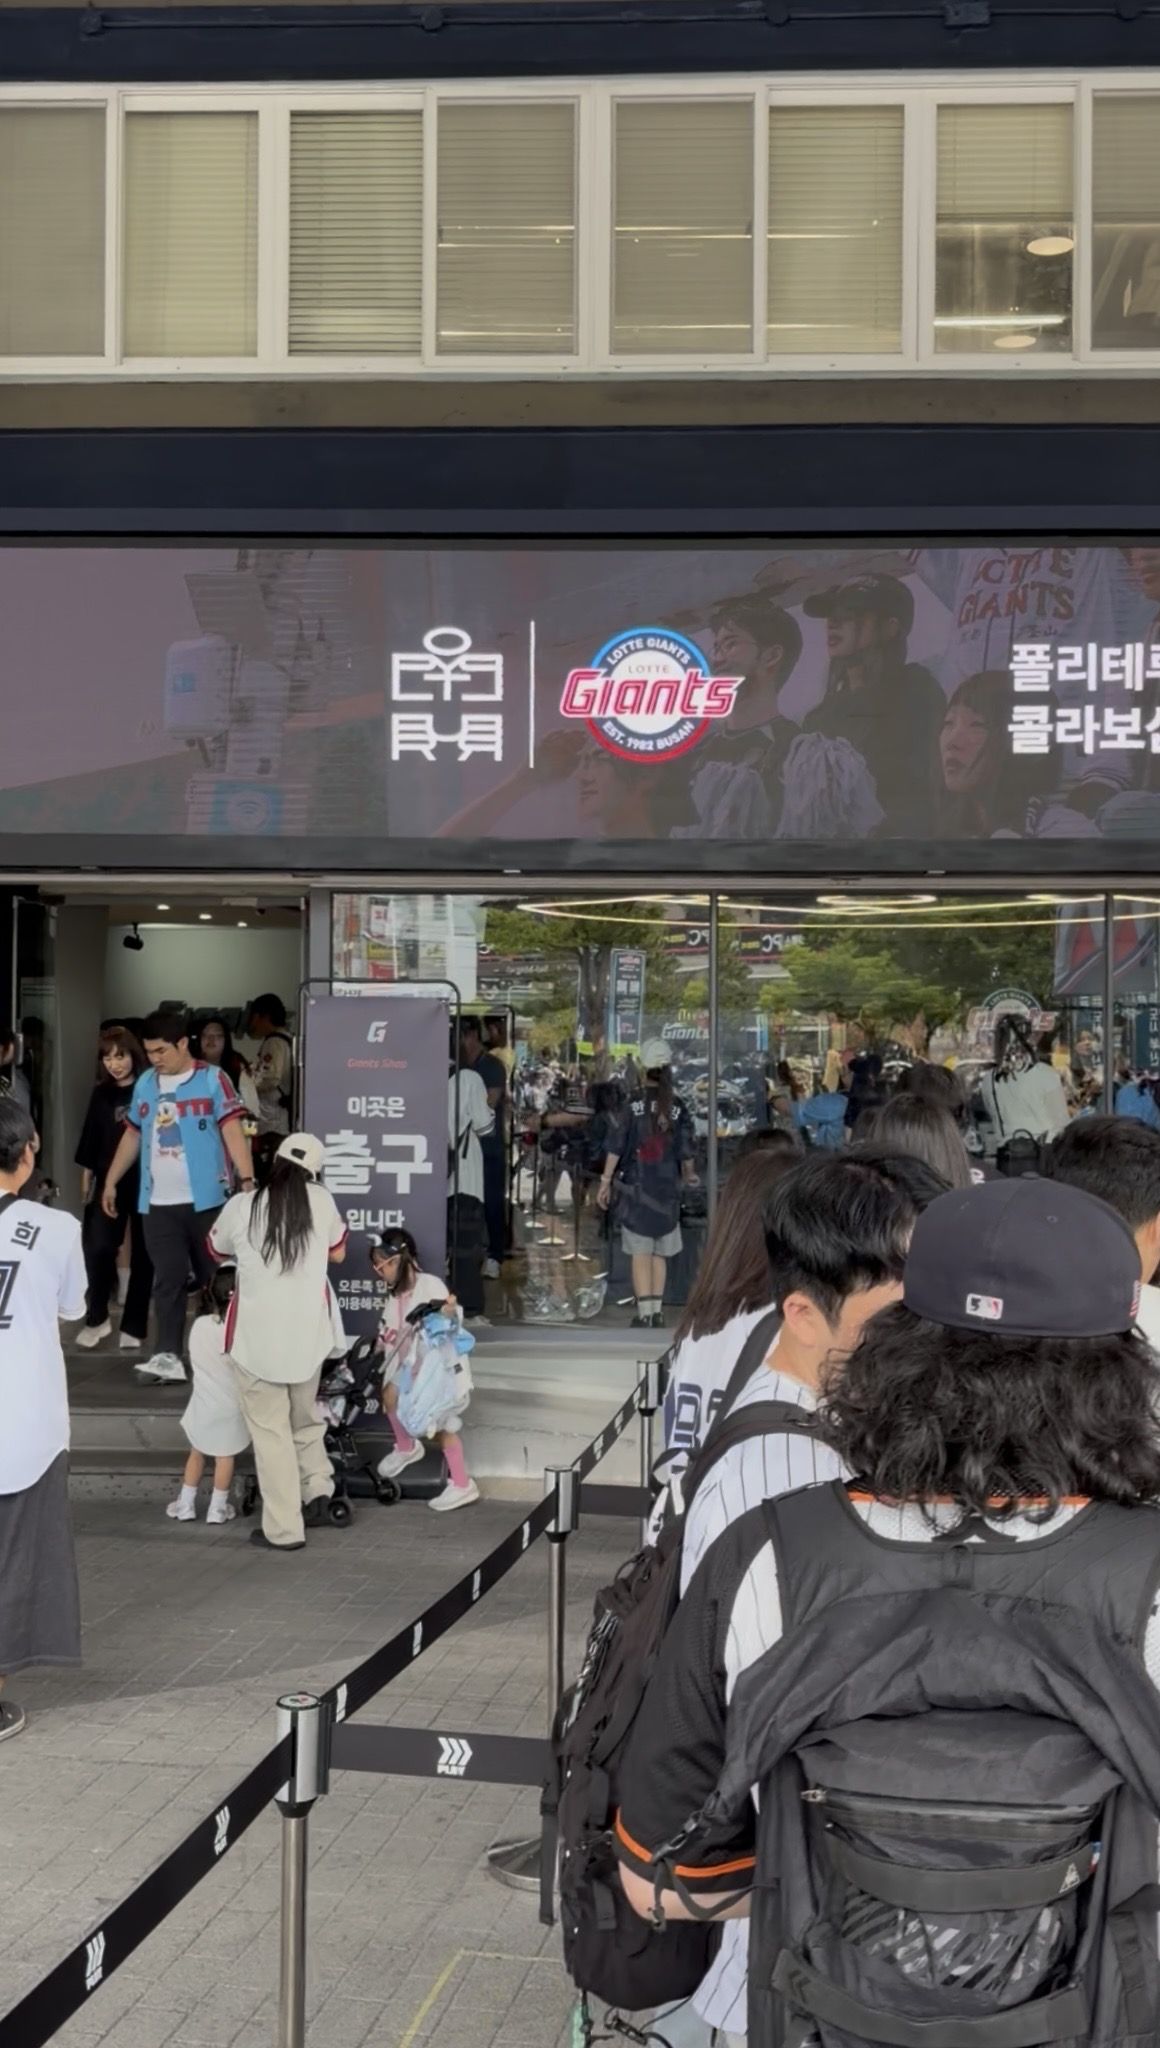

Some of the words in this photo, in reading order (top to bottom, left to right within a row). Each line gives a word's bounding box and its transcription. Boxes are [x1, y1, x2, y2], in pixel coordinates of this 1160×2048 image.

[606, 637, 644, 665] LOTTE
[647, 637, 692, 665] GIANTS
[628, 665, 670, 674] LOTTE
[560, 668, 745, 717] Giants
[602, 721, 624, 745] EST.
[626, 737, 654, 751] 1982
[656, 721, 696, 750] BUSAN
[347, 1096, 406, 1118] 이곳은
[324, 1130, 433, 1194] 출구
[346, 1209, 405, 1231] 입니다
[10, 1220, 41, 1251] 희
[338, 1279, 373, 1293] 오른쪽
[375, 1279, 393, 1294] 입
[338, 1296, 388, 1311] 이용해주
[437, 1764, 466, 1777] PLAY
